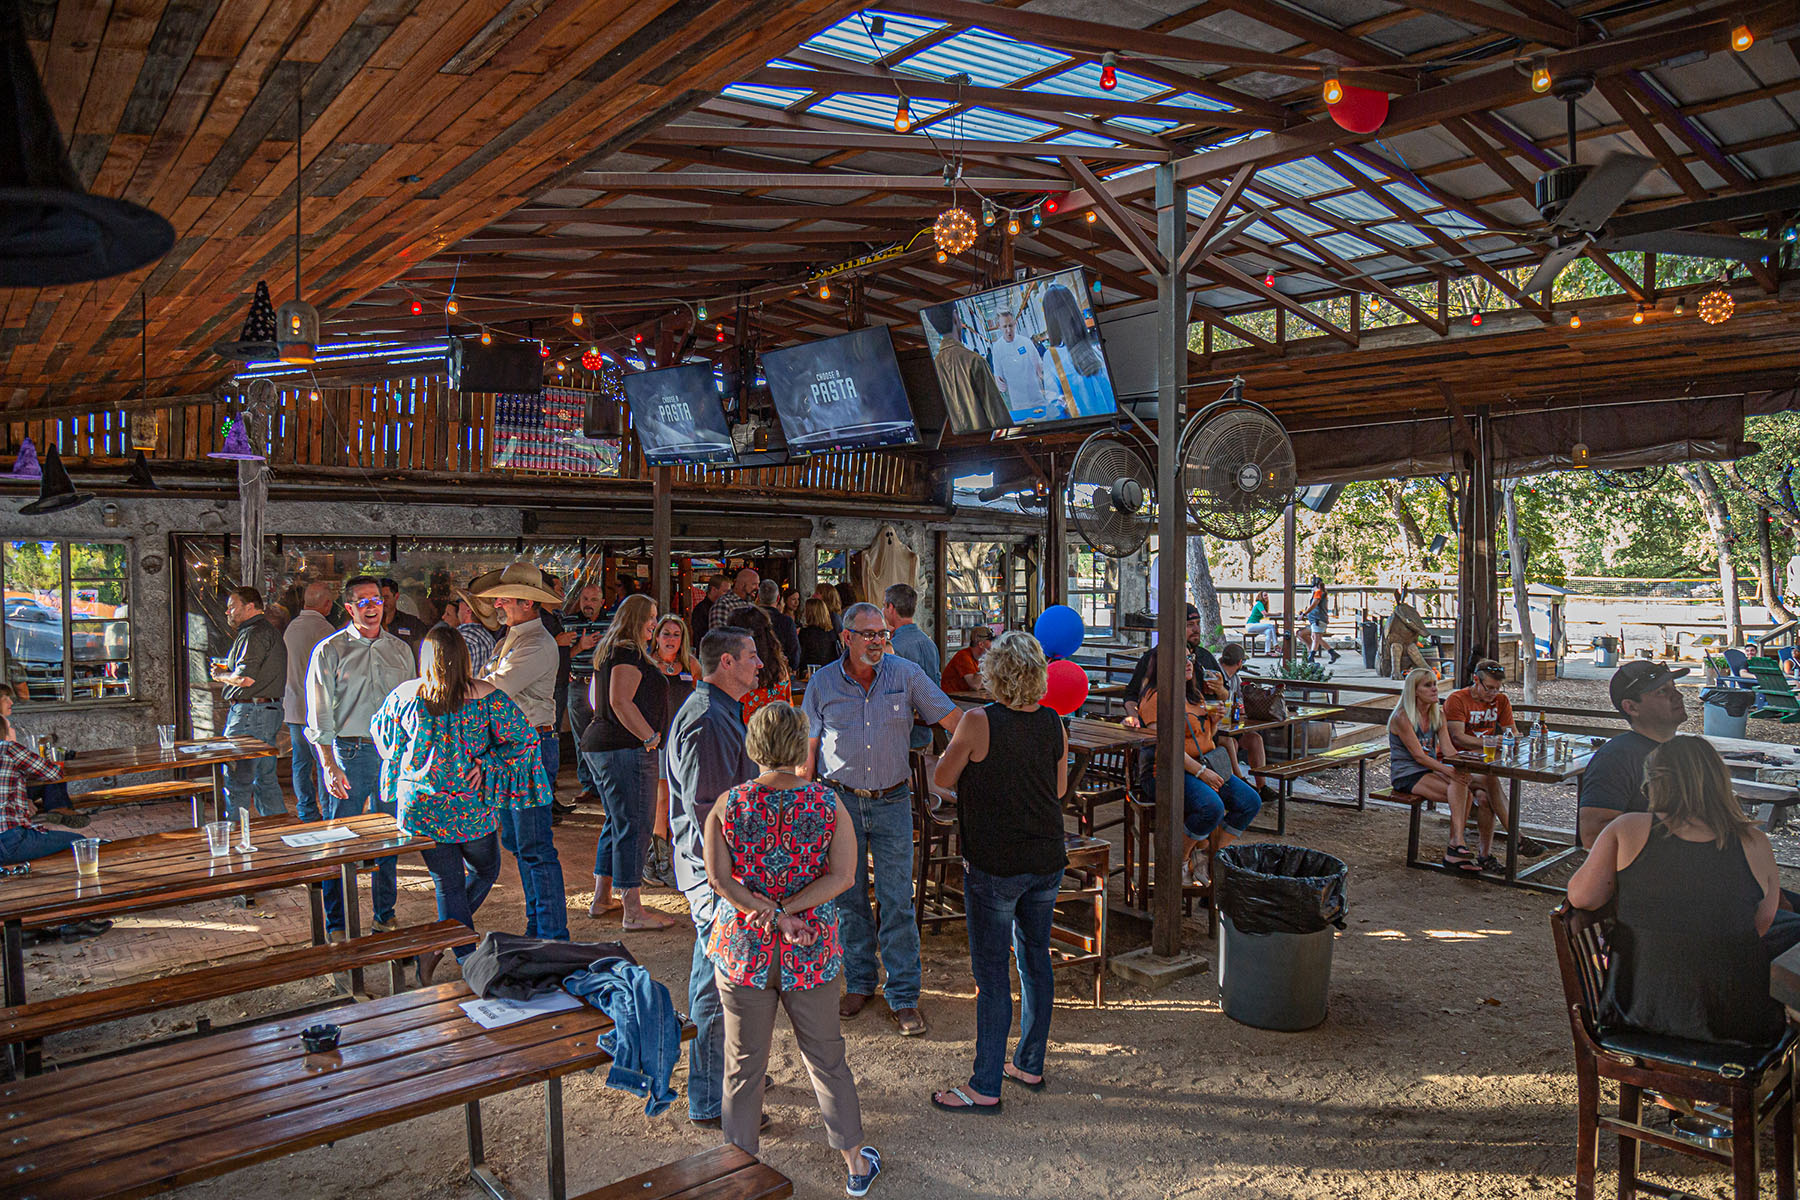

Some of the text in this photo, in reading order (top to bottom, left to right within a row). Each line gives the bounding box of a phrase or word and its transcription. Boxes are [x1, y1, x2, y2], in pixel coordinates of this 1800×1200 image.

[815, 371, 835, 382] CHOOSE
[810, 377, 858, 405] PASTA
[658, 402, 692, 422] PASTA
[1469, 708, 1498, 724] TEAS
